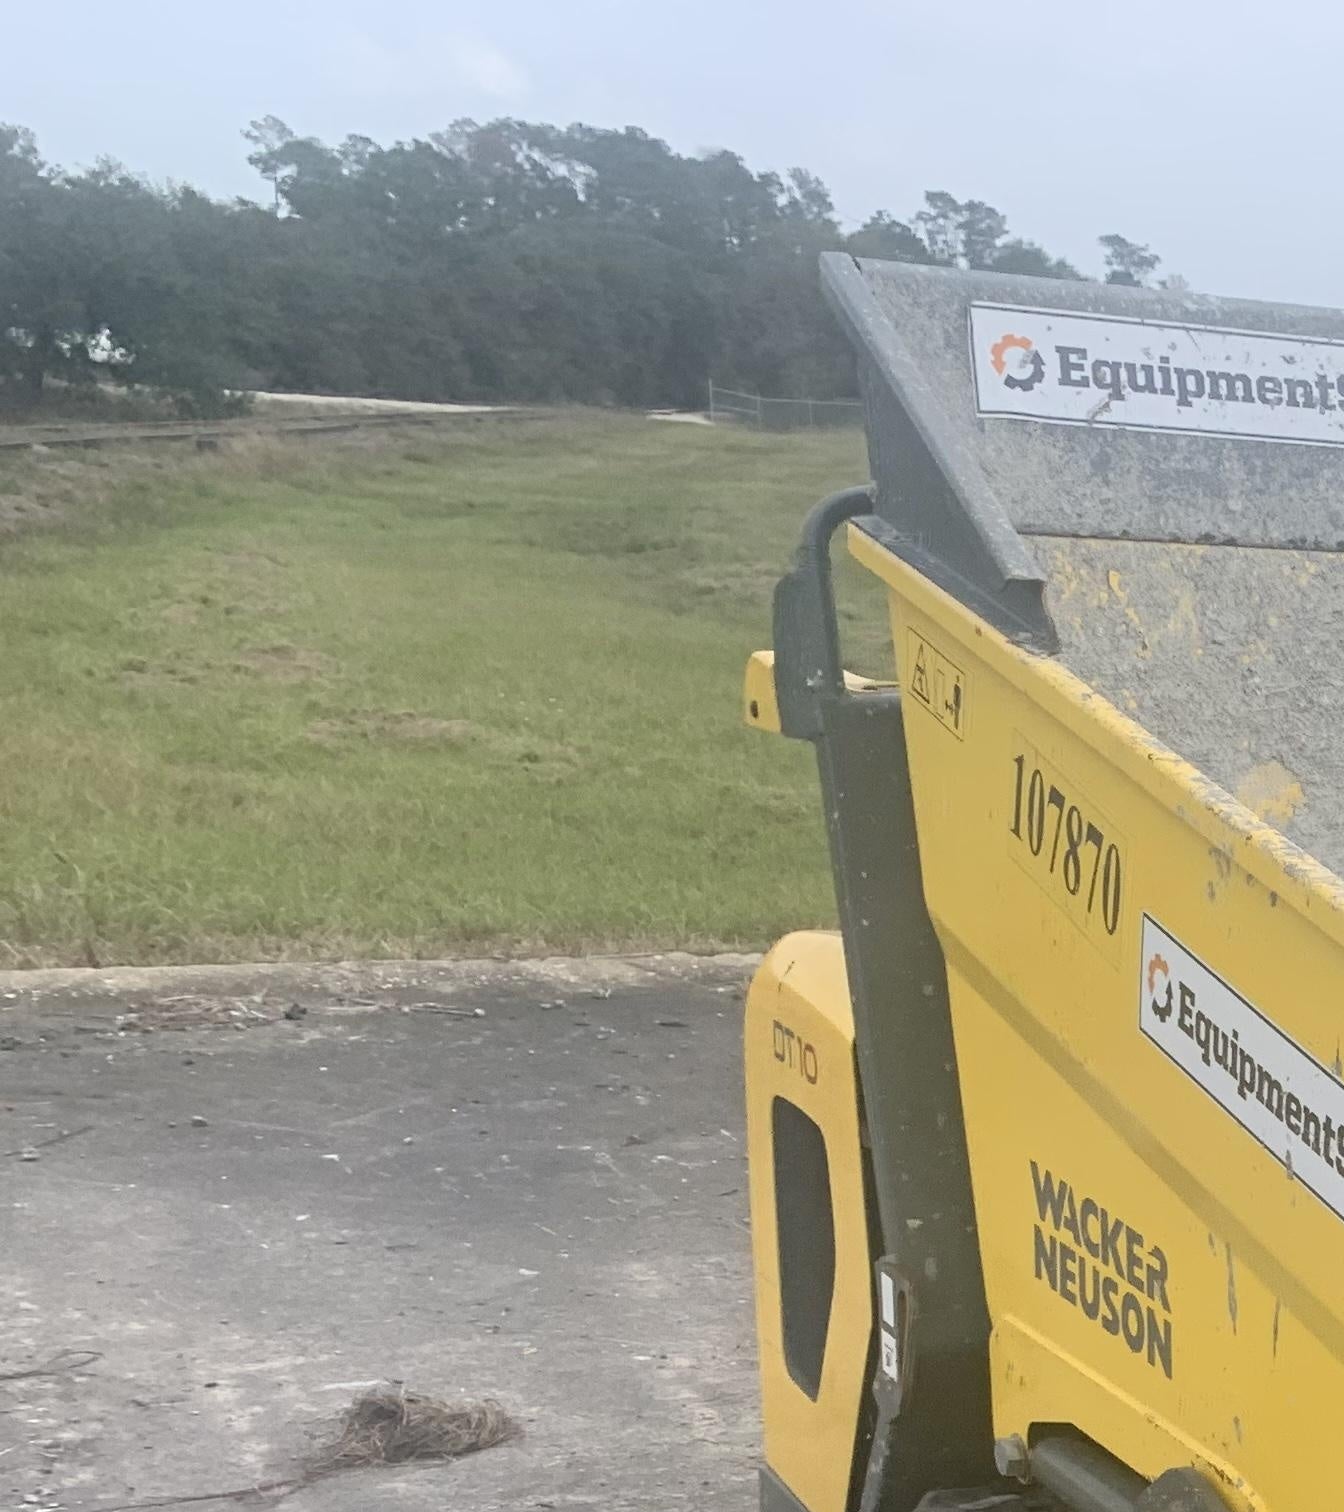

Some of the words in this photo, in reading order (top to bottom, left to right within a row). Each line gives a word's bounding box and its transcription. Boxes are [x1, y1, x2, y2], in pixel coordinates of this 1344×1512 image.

[1010, 754, 1121, 936] 107870
[1030, 1159, 1171, 1314] WACKER
[1034, 1224, 1173, 1381] NEUSON
